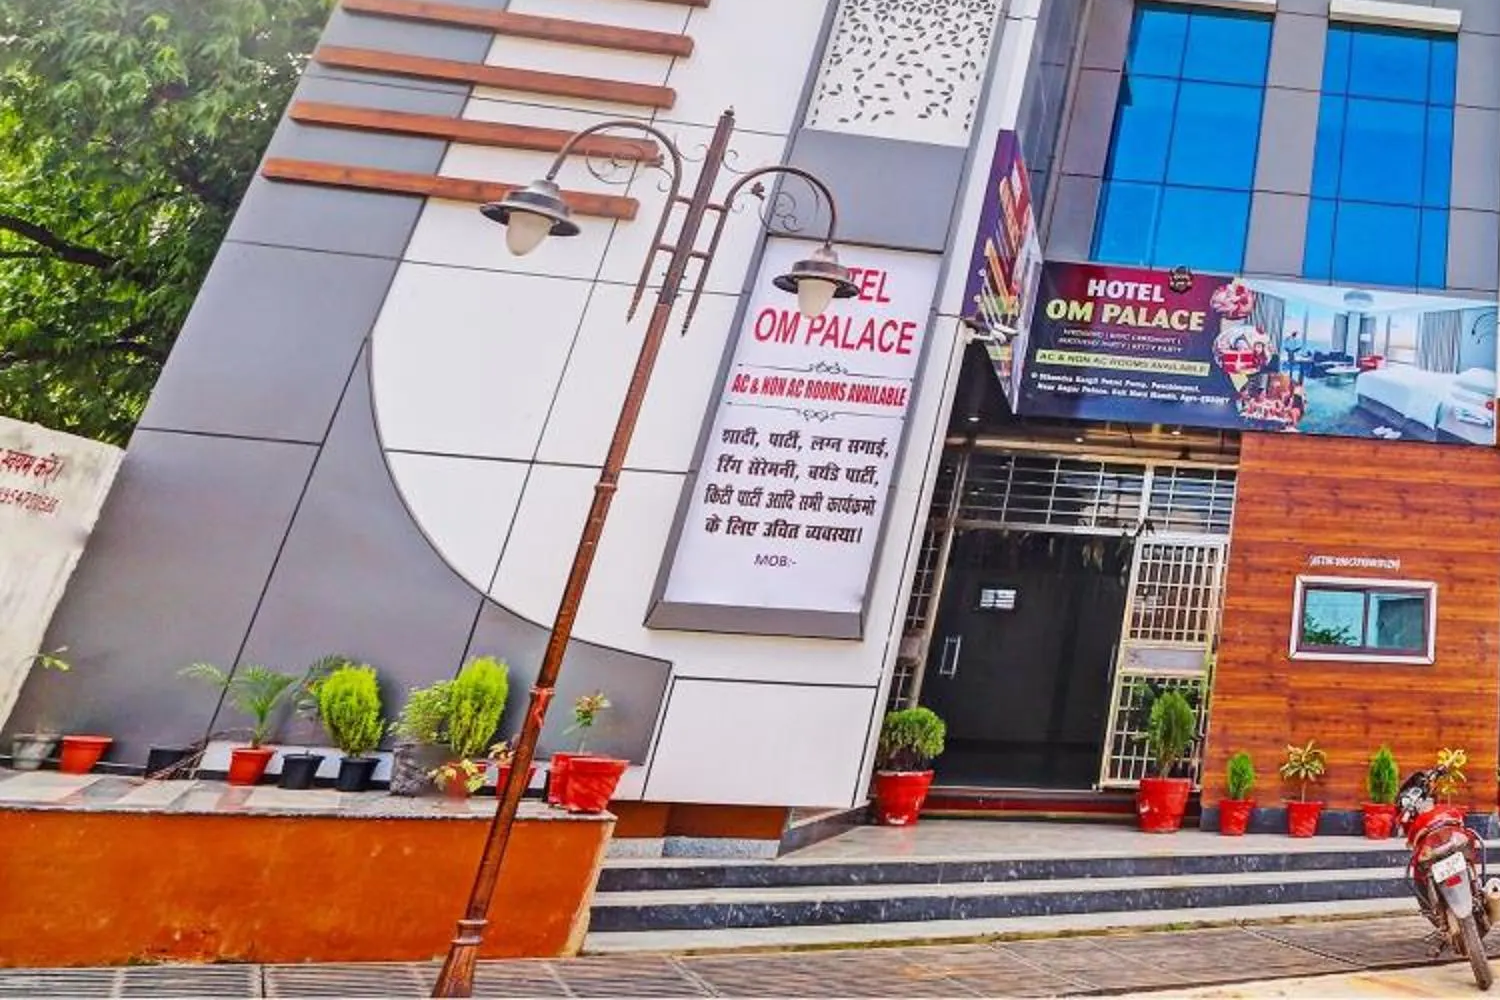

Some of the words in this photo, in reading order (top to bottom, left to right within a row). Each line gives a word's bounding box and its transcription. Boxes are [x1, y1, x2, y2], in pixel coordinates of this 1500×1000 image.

[1087, 278, 1165, 302] HOTEL
[1046, 299, 1094, 322] OM
[1101, 303, 1207, 331] PALACE
[755, 308, 801, 344] OM
[805, 312, 917, 355] PALACE
[1039, 353, 1057, 361] AC
[1067, 354, 1091, 364] NON
[732, 373, 750, 393] AC
[750, 379, 759, 394] &
[760, 376, 785, 397] NON
[786, 377, 805, 399] AC
[804, 379, 848, 402] ROOMS
[848, 383, 908, 407] AVAILABLE
